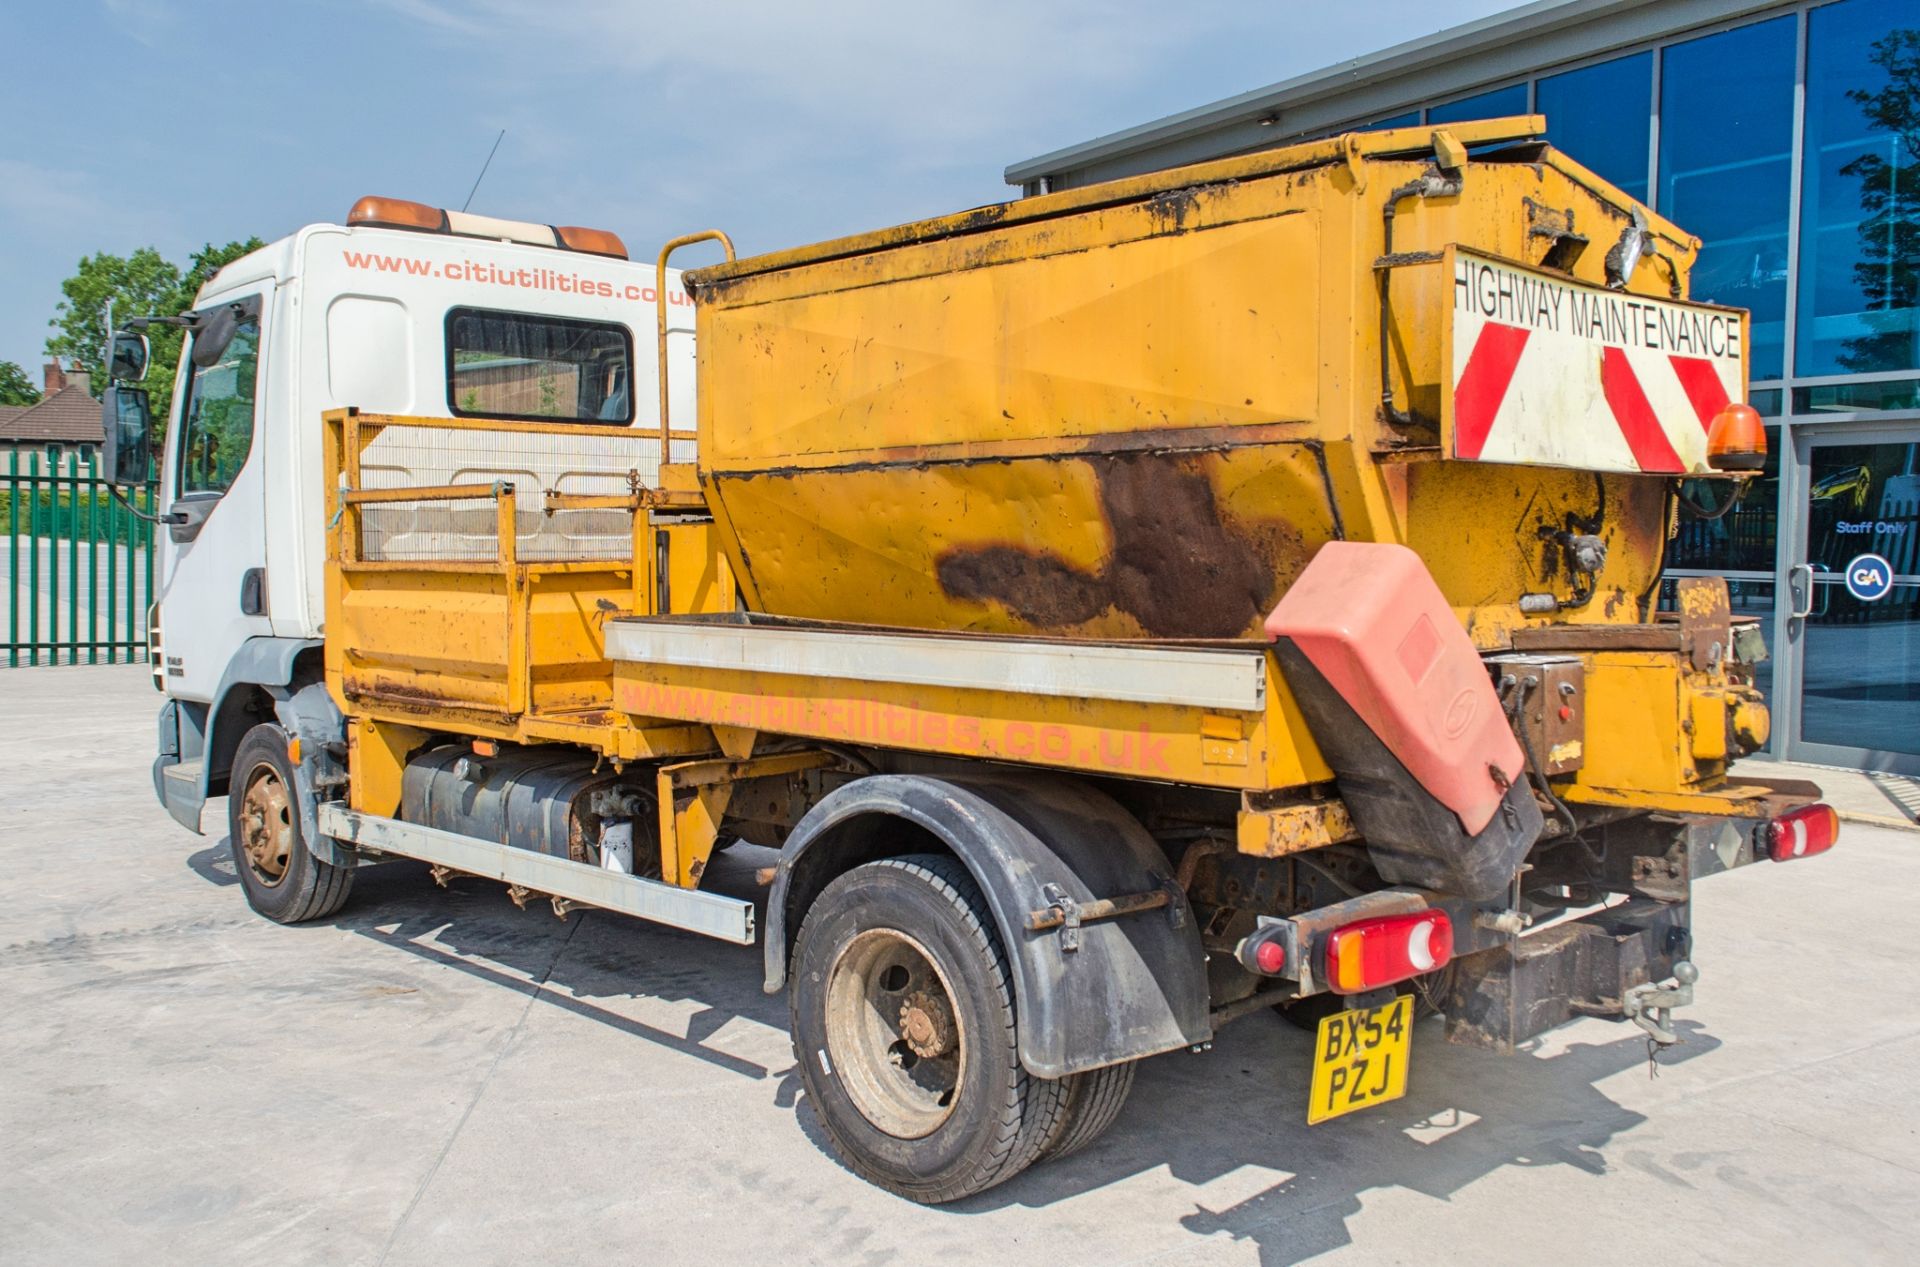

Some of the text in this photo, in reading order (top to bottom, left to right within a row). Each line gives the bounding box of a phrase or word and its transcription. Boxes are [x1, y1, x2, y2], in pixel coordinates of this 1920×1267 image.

[343, 250, 698, 307] www.citiutilities.cou
[1454, 259, 1740, 359] HIGHWAY MAINTENANCE
[1836, 520, 1908, 537] Staff Only
[1853, 568, 1884, 587] GA
[623, 683, 1172, 773] www.citiutilities.co.uk
[1324, 1001, 1403, 1063] BX54
[1328, 1053, 1391, 1111] PZJ
